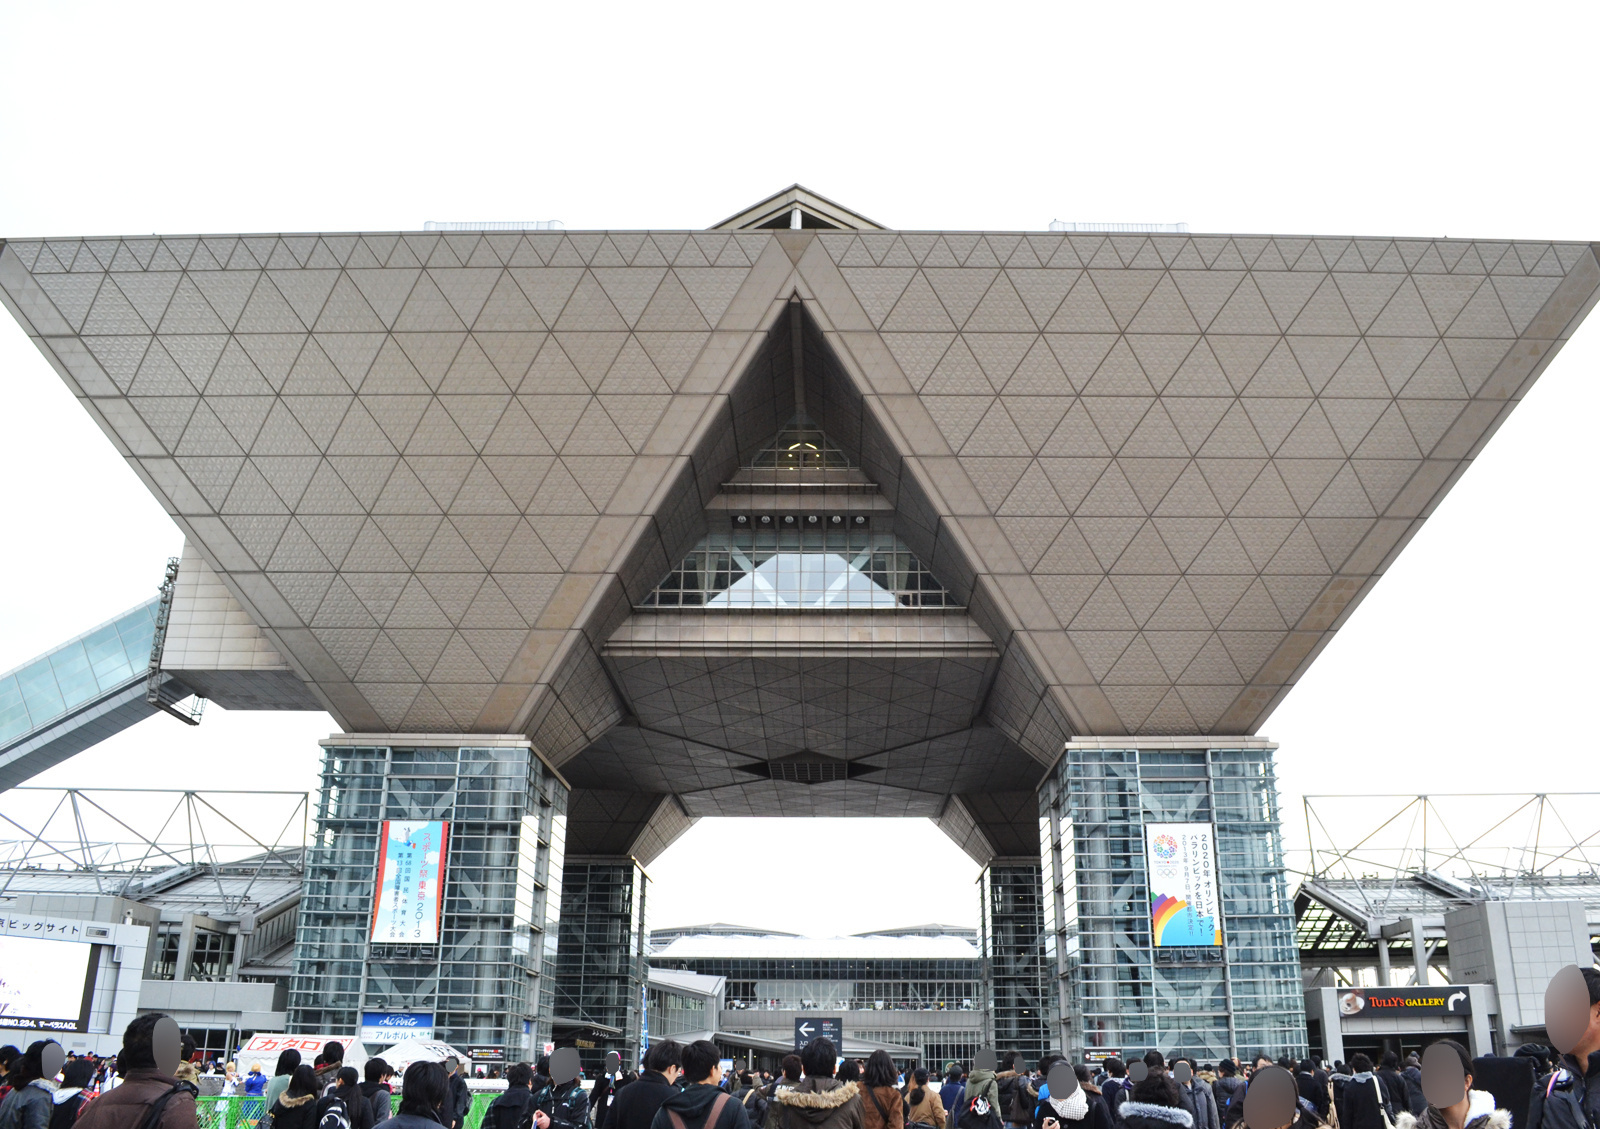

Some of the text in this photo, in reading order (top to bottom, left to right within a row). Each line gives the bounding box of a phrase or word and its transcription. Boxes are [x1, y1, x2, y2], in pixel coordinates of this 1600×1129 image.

[1405, 997, 1445, 1007] GALLERY
[257, 1038, 348, 1051] カタロ
